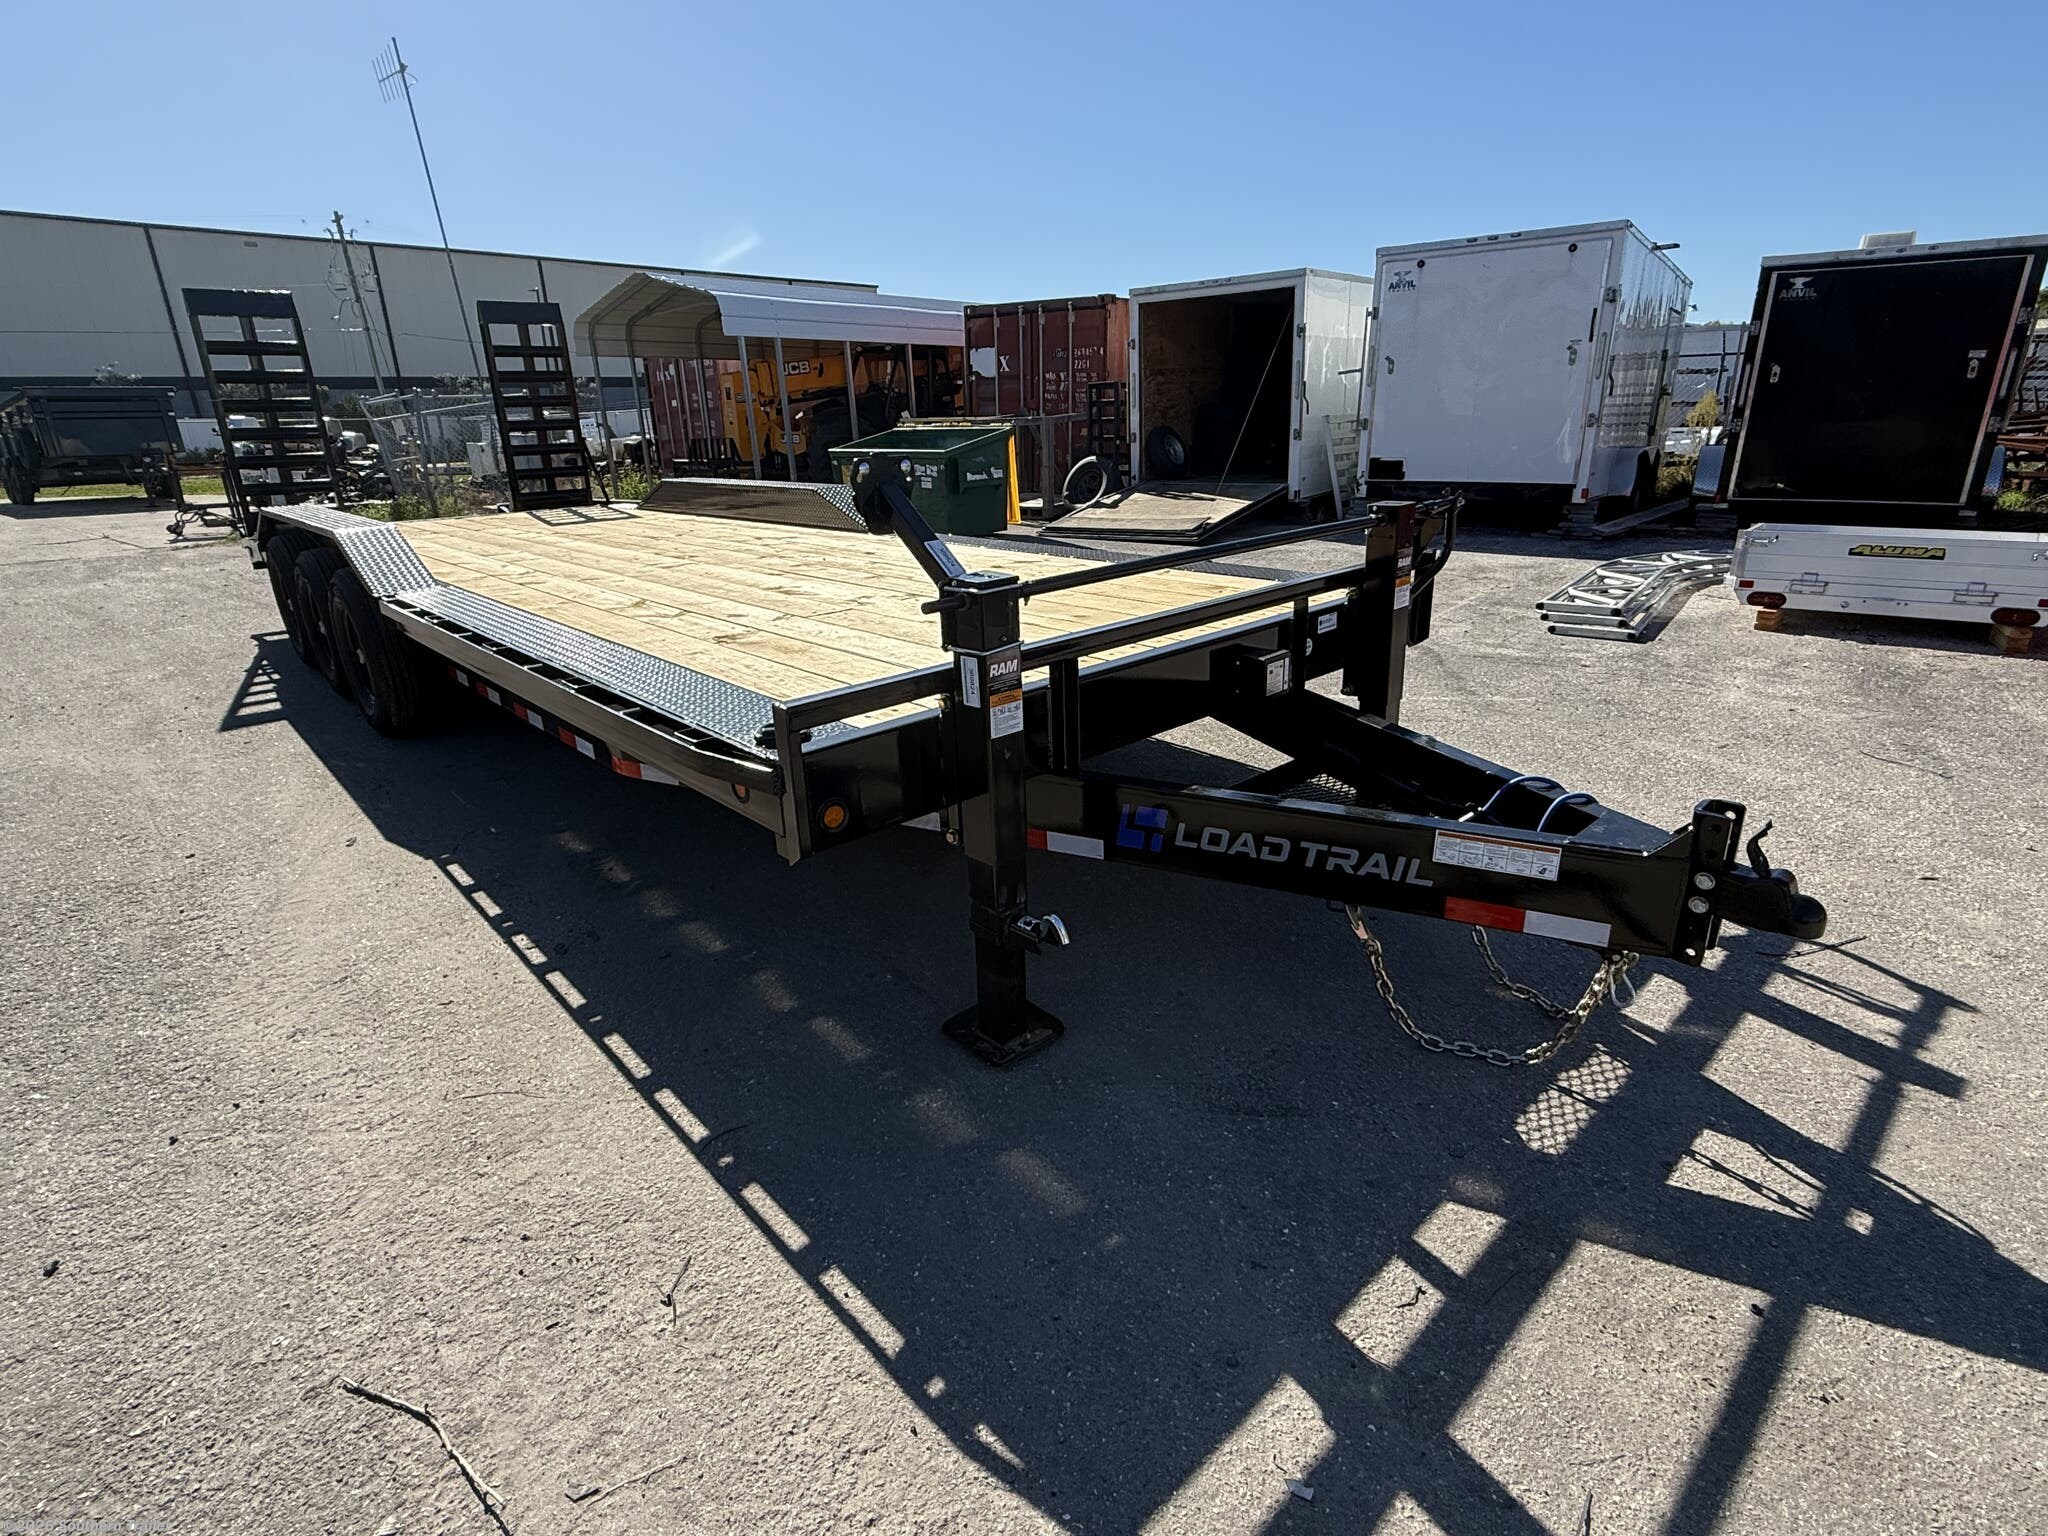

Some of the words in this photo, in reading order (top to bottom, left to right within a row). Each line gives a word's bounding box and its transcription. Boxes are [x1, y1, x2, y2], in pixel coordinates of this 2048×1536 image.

[1388, 280, 1416, 290] ANVIL
[1779, 288, 1817, 298] ANVIL
[783, 361, 811, 376] JCB
[781, 433, 801, 444] JB
[1851, 544, 1945, 558] ALUMA
[989, 658, 1019, 678] RAM
[1174, 821, 1292, 863] LOAD
[1299, 840, 1434, 887] TRAIL
